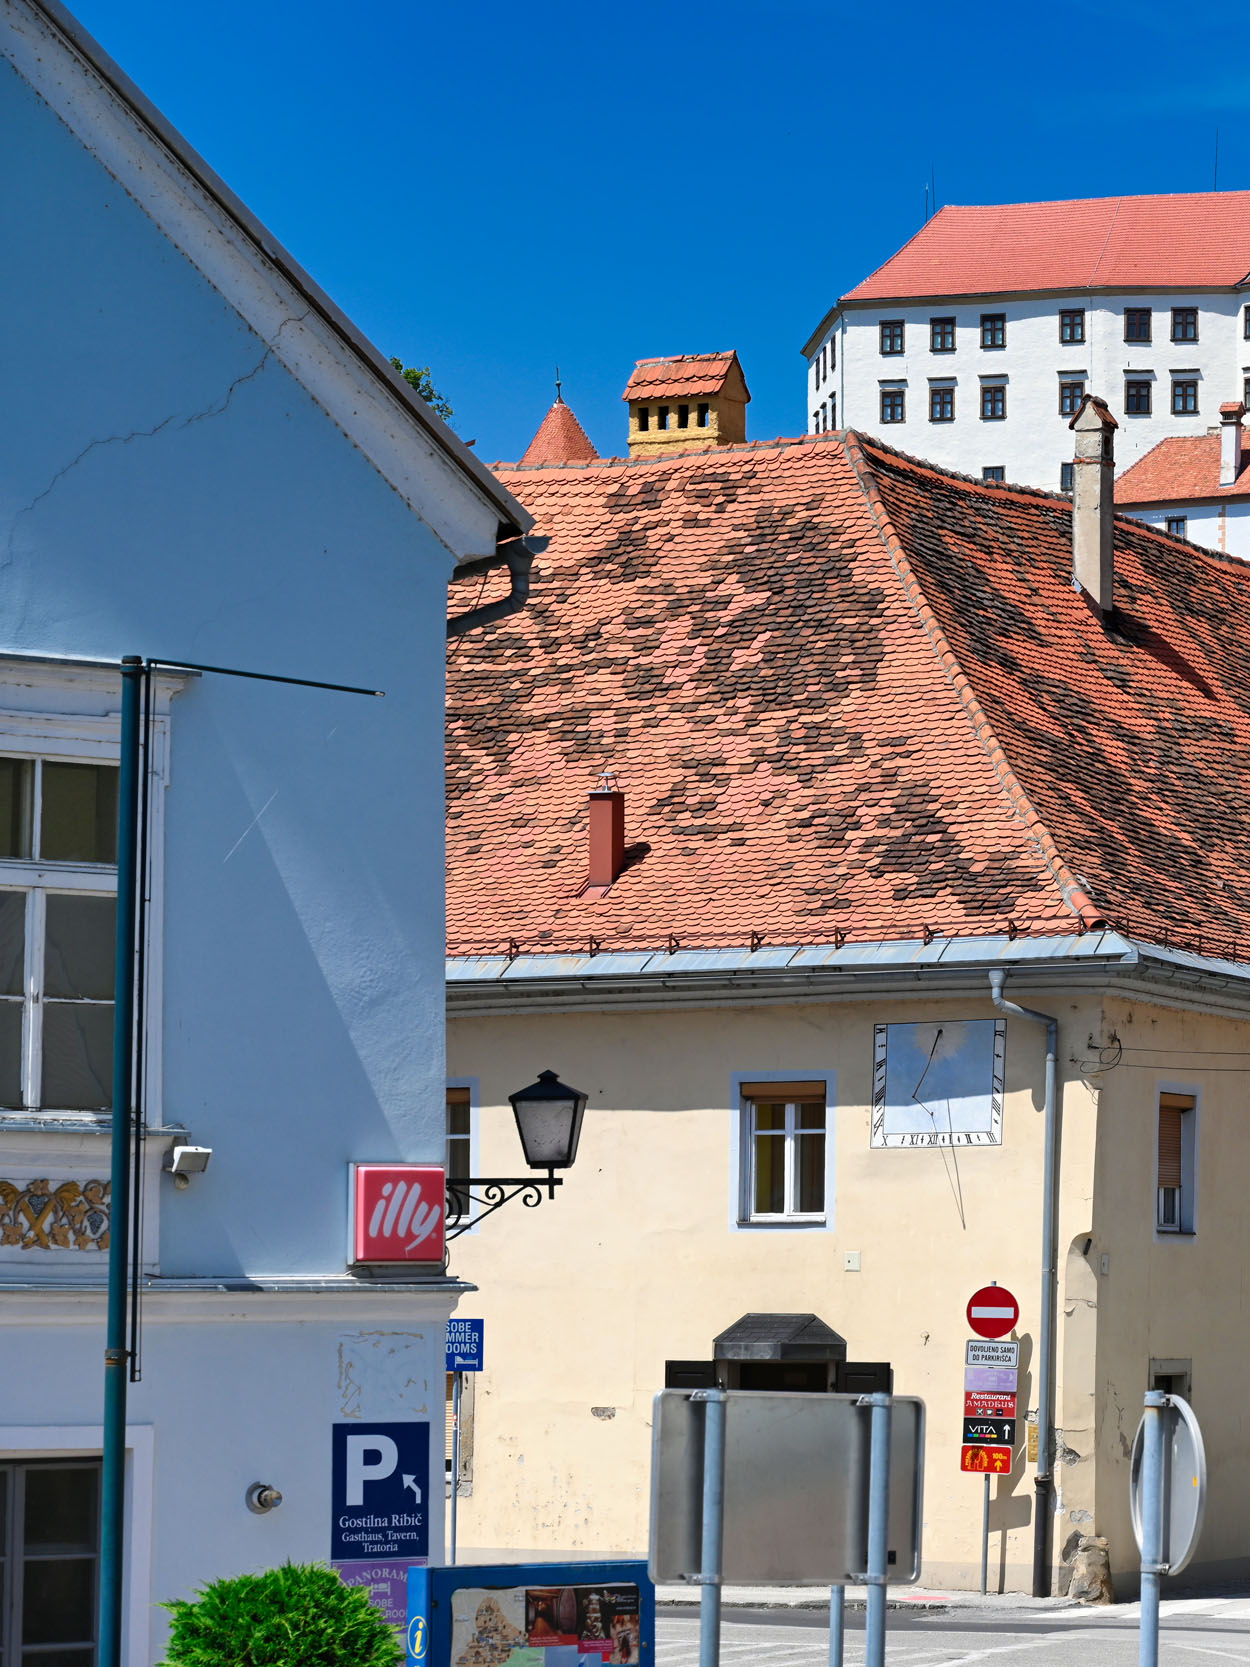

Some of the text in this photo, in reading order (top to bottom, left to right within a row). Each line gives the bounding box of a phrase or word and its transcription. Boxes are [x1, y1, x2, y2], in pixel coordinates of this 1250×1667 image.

[369, 1180, 441, 1258] illy
[446, 1332, 479, 1343] MMER
[446, 1343, 477, 1354] OOMS
[970, 1345, 998, 1353] DOVOLJENO
[971, 1392, 1011, 1401] Restaurant
[965, 1400, 1015, 1408] AMADEUS
[346, 1434, 398, 1506] P
[339, 1512, 422, 1529] Gostilna Ribič
[341, 1529, 420, 1543] Gasthaus, Tavern,
[362, 1541, 399, 1553] Tratoria
[347, 1567, 409, 1588] PANORAM
